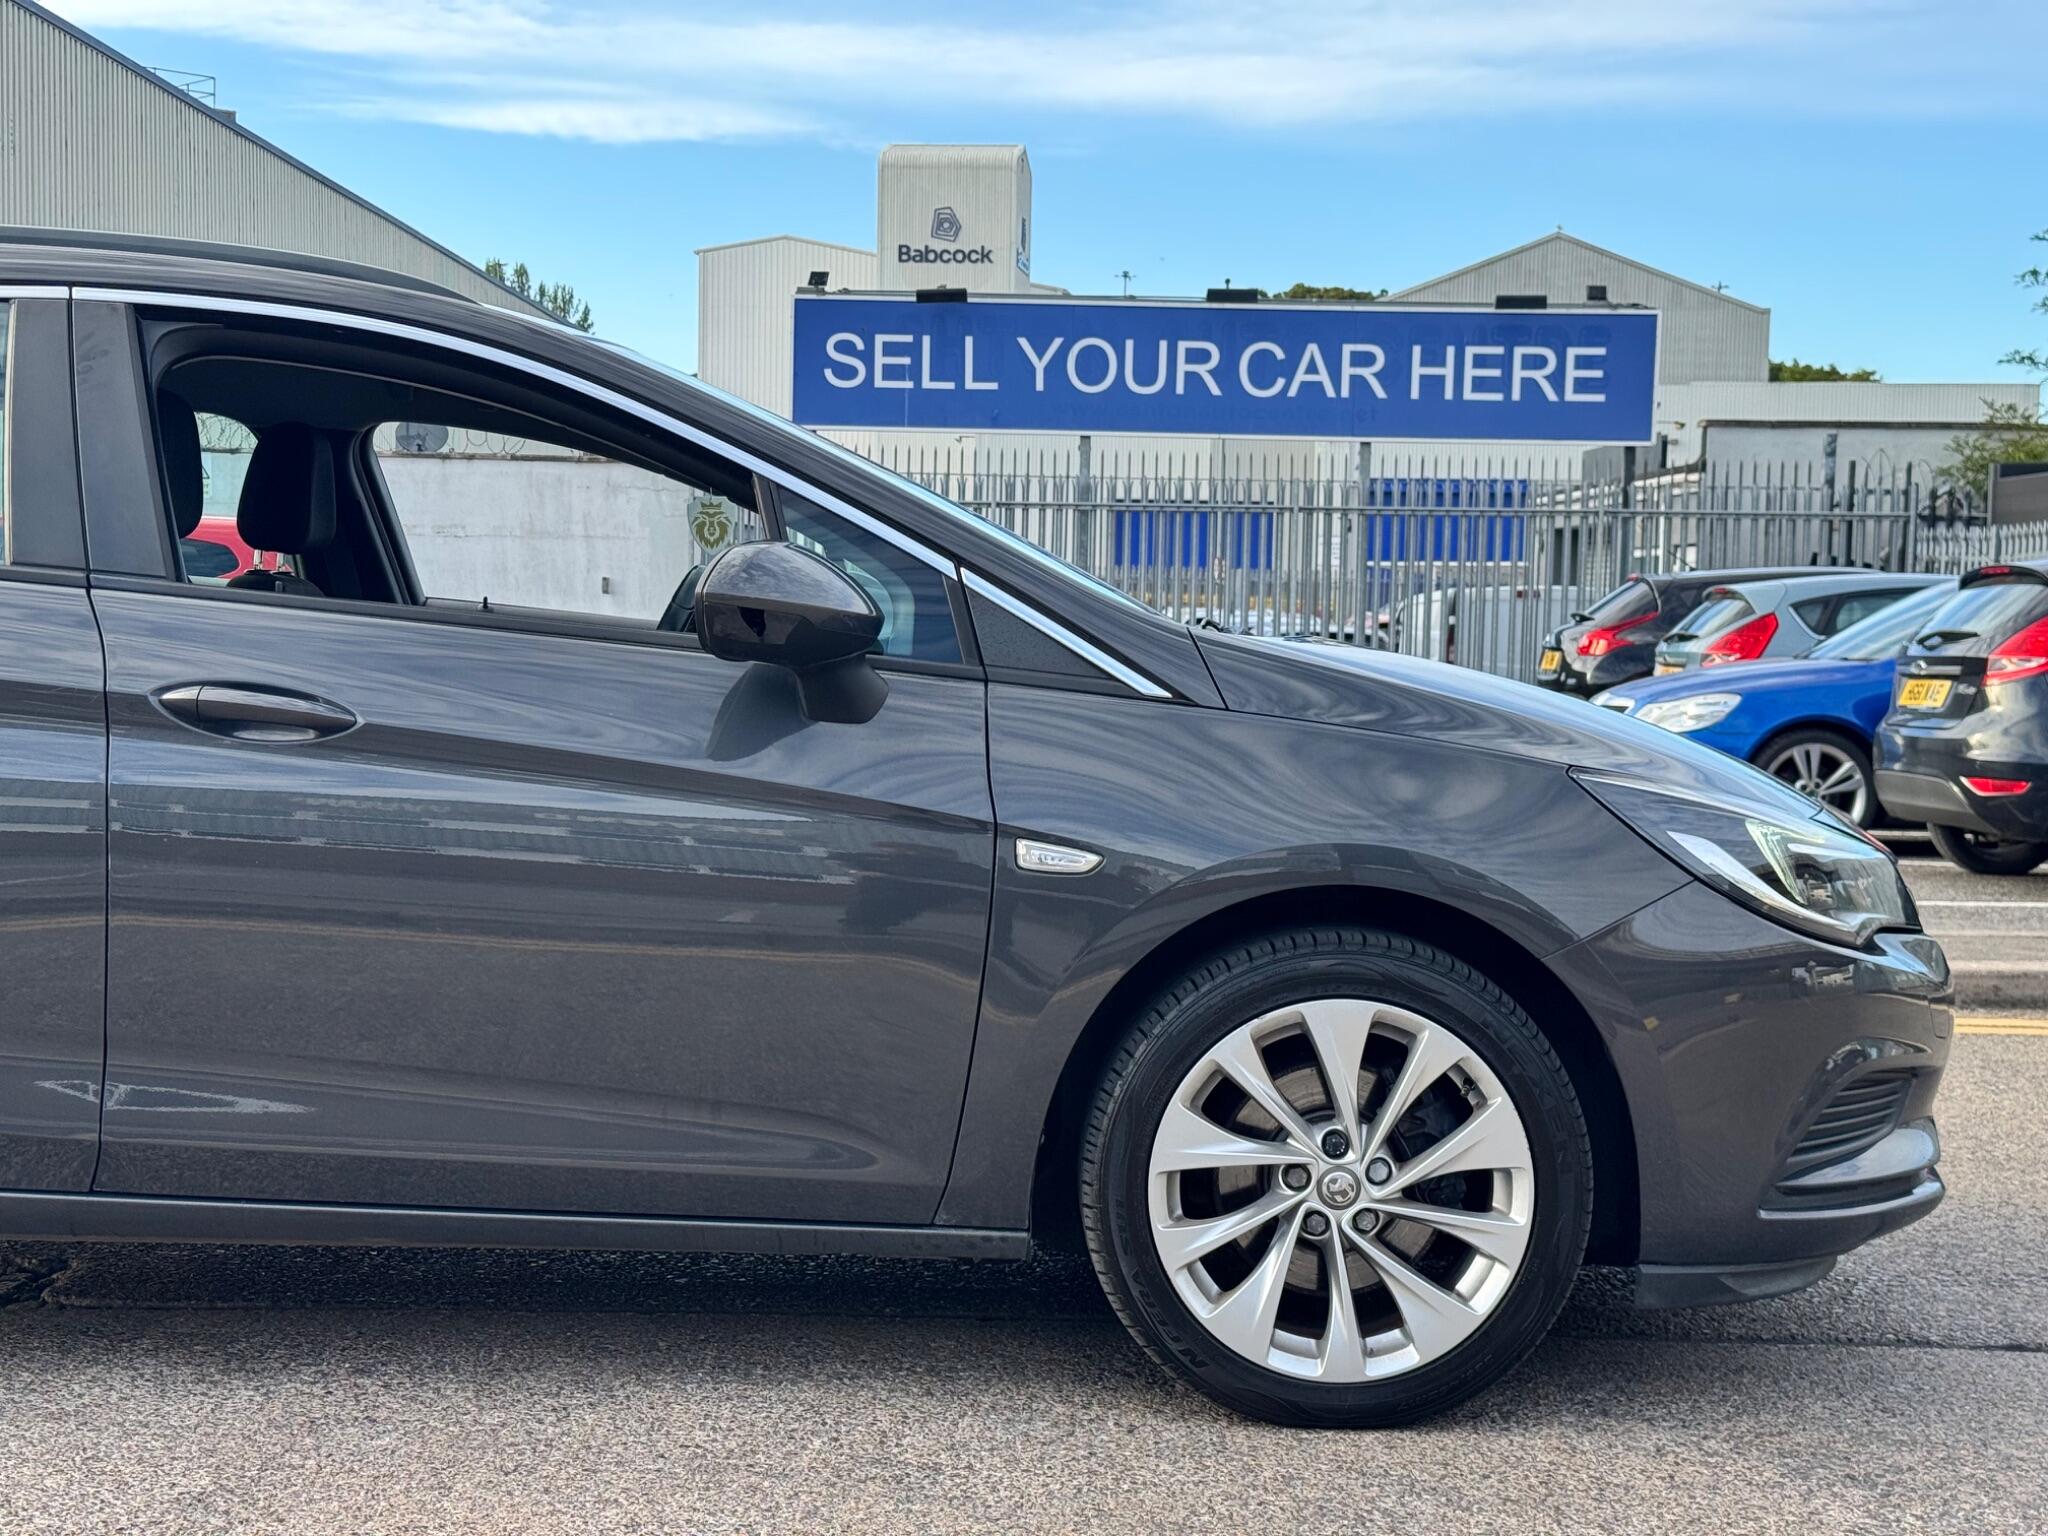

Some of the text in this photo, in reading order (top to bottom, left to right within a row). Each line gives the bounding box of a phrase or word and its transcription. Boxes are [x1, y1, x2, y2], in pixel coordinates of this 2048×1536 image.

[897, 244, 994, 264] Babcock
[823, 332, 1607, 402] SELL YOUR CAR HERE
